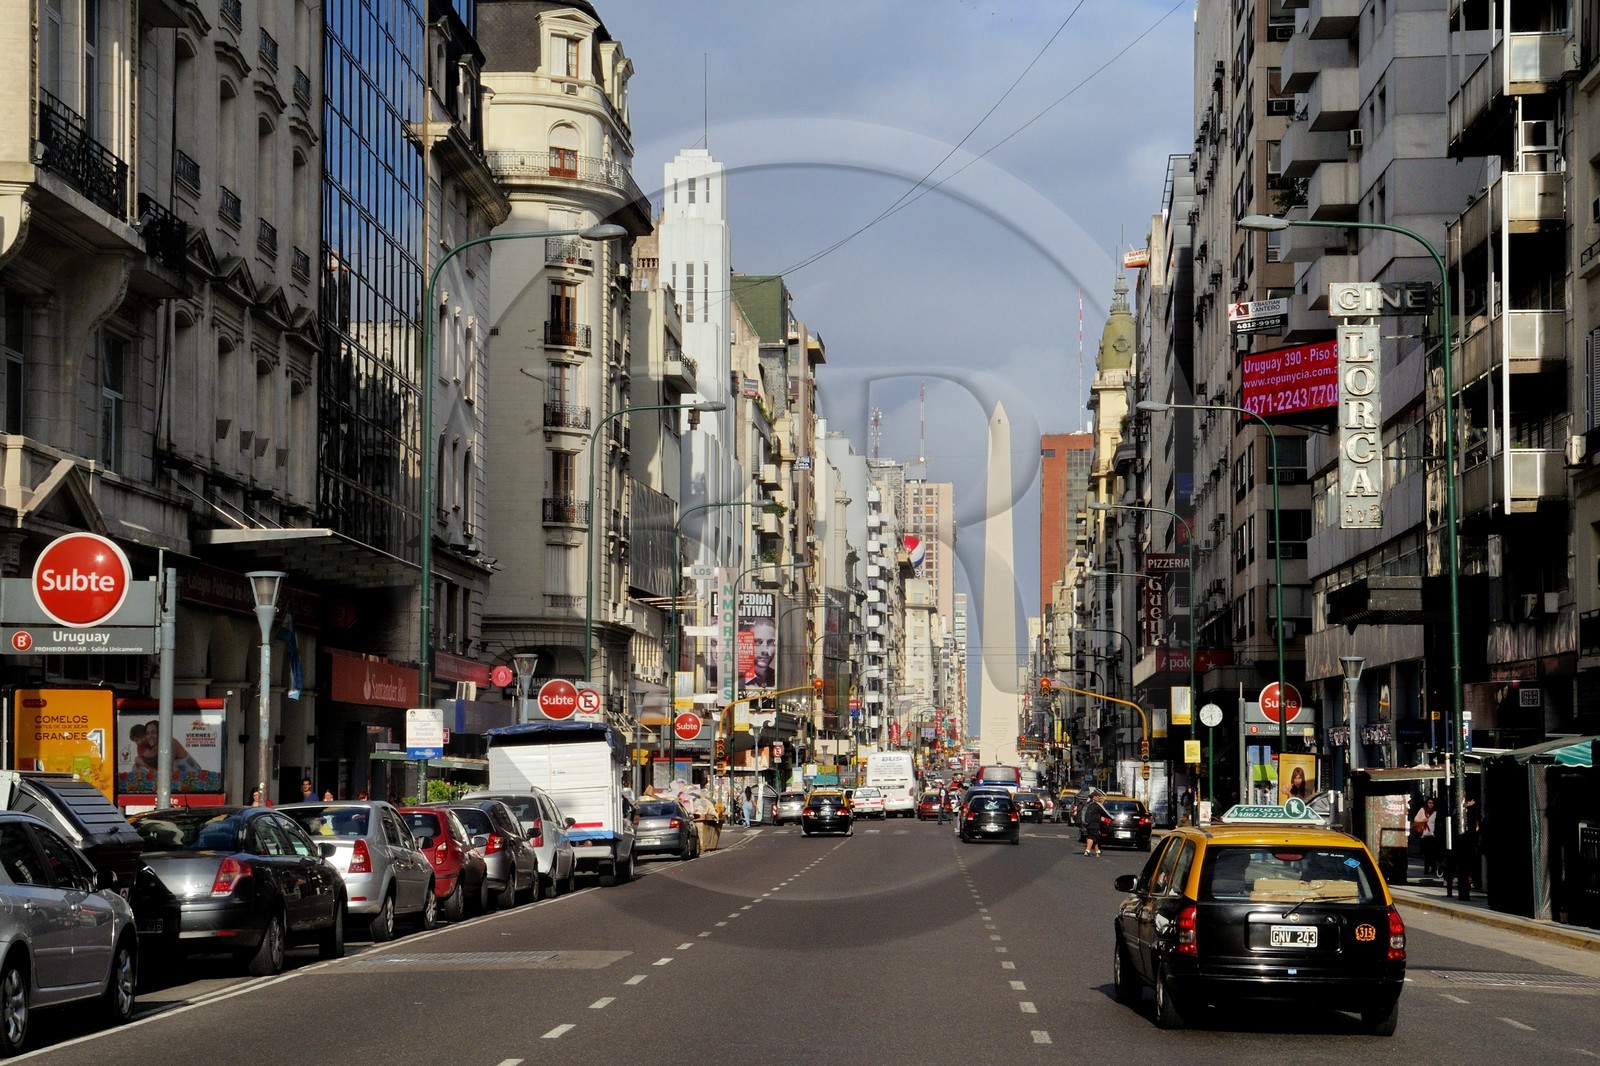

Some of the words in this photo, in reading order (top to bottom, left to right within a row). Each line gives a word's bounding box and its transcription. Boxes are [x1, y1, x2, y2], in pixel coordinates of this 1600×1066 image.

[1251, 300, 1281, 308] SEBASTIAN
[1338, 287, 1426, 311] CINE
[1251, 304, 1281, 313] CANTERO
[1236, 319, 1280, 330] 4812-9999
[1244, 357, 1281, 374] Uruguay
[1285, 351, 1301, 366] 390
[1310, 348, 1330, 362] Piso
[1345, 332, 1377, 497] LORCA
[1346, 504, 1353, 523] 1
[1369, 504, 1380, 523] 2
[693, 568, 711, 576] LOS
[42, 569, 115, 592] Subte
[17, 635, 26, 647] B
[53, 632, 110, 645] Uruguay
[722, 572, 734, 700] INMORTALES
[542, 694, 574, 706] Subte
[1265, 698, 1297, 709] Sute
[35, 715, 89, 724] COMELOS
[35, 732, 89, 741] GRANDES
[155, 797, 179, 805] Ste
[1273, 931, 1291, 942] GNV
[1297, 931, 1316, 943] 243
[1359, 927, 1373, 939] 315
